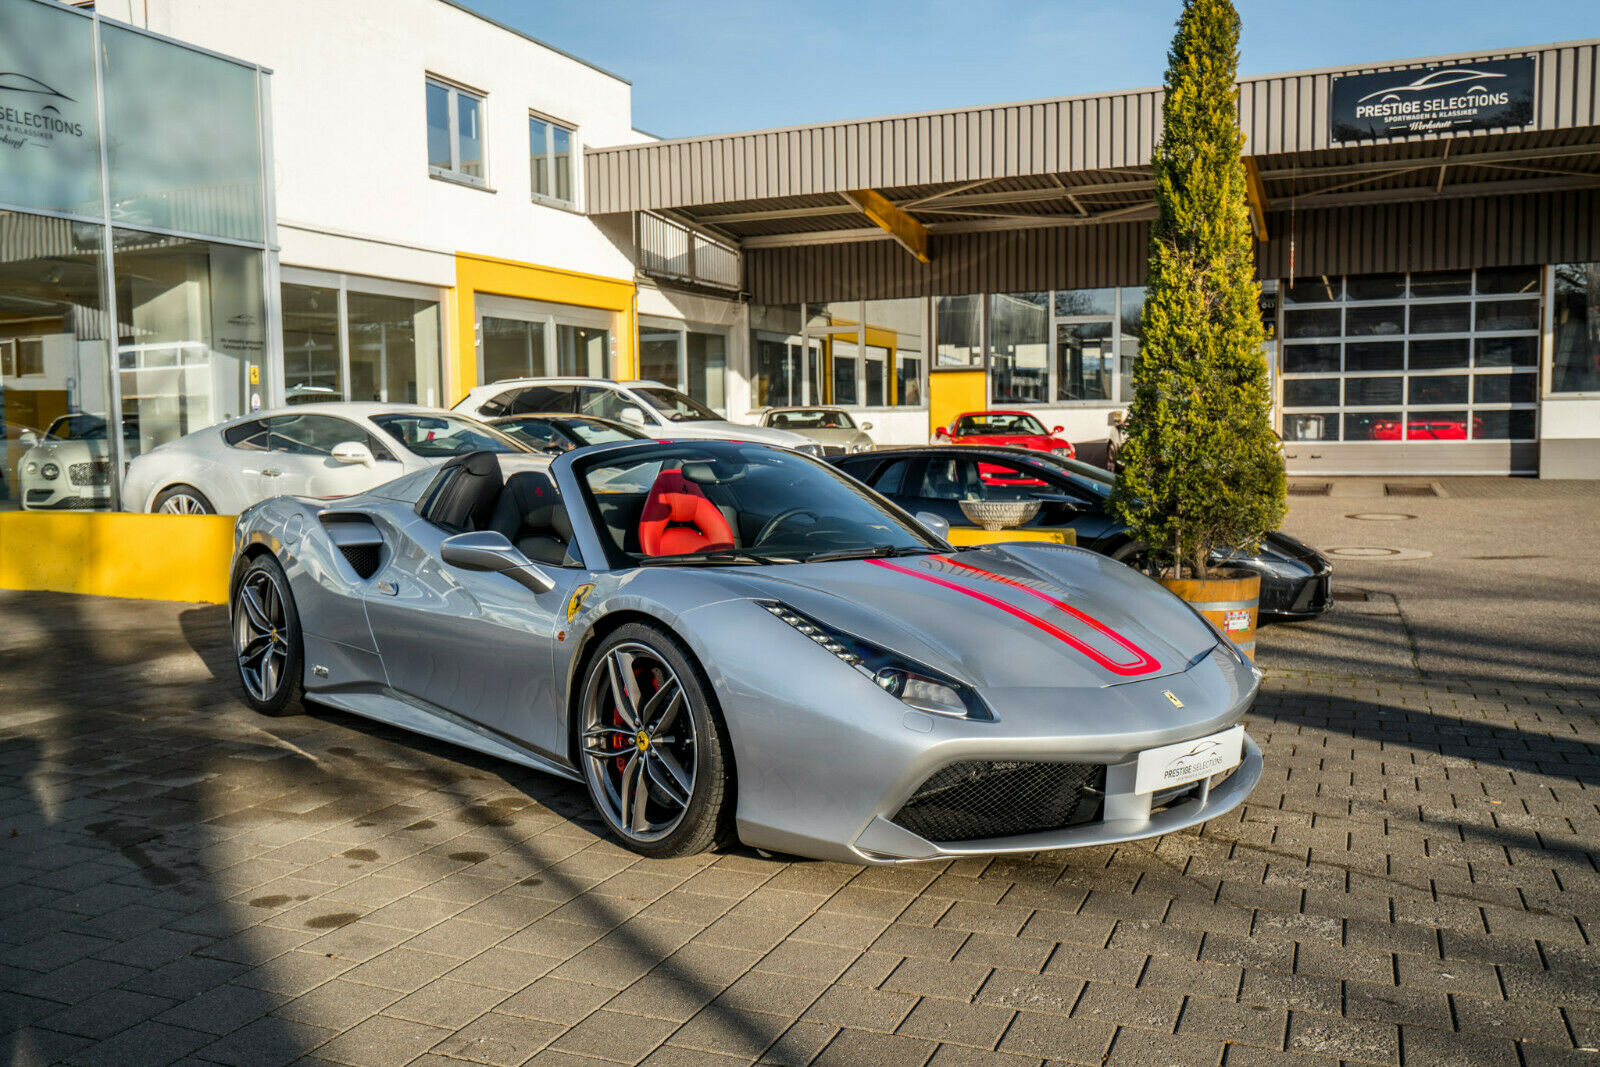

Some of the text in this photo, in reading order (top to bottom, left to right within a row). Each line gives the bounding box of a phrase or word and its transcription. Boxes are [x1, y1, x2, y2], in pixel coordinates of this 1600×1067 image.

[1356, 92, 1509, 119] PRESTIGE SELECTIONS
[1384, 113, 1431, 124] SPORTWAGEN
[1438, 108, 1478, 118] KLASSIKER
[1164, 764, 1192, 780] PRESTIGE
[1192, 755, 1223, 772] SELECTIONS
